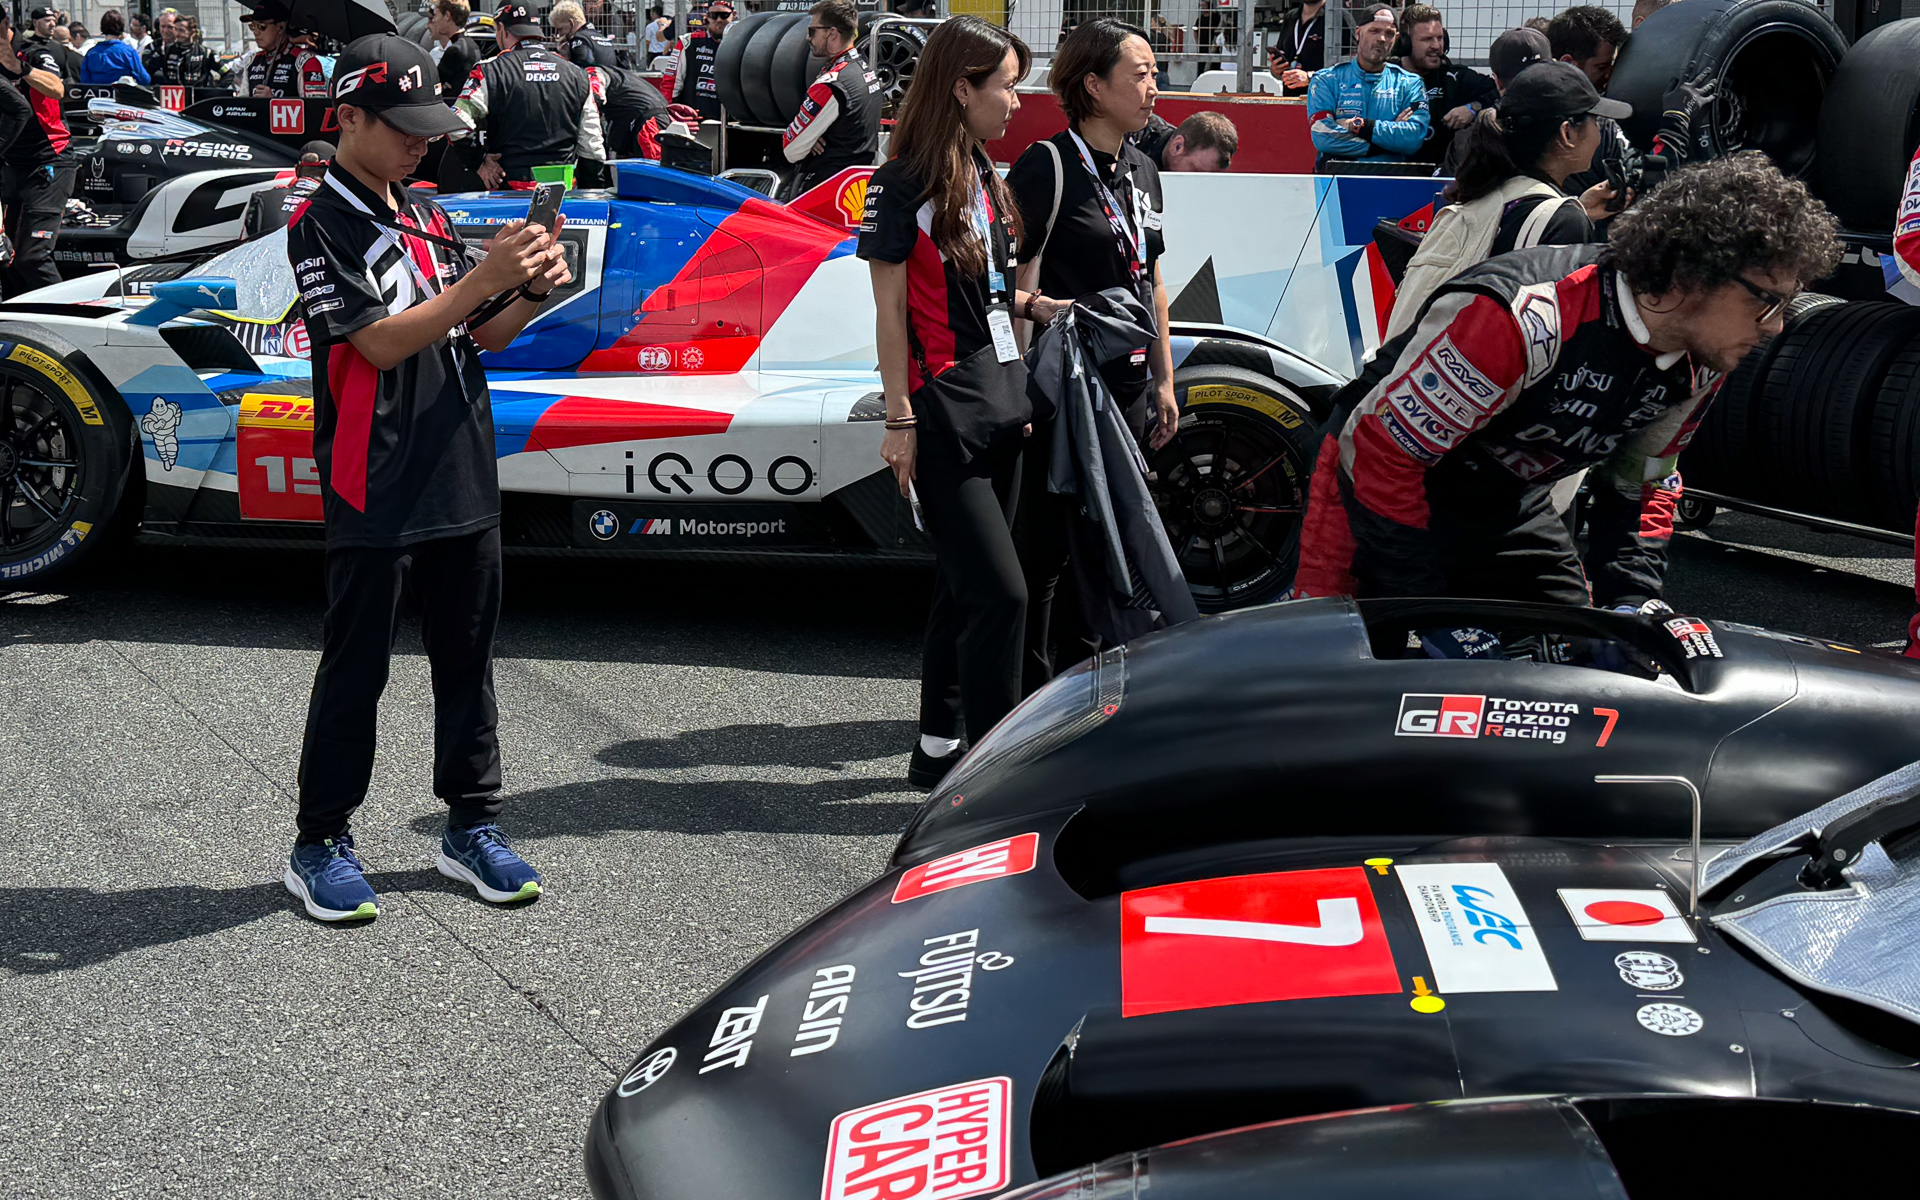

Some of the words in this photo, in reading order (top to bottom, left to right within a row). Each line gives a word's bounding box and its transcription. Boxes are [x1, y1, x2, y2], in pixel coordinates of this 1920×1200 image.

[336, 62, 388, 98] GR
[399, 64, 422, 92] #7
[526, 73, 560, 81] DENSO
[161, 89, 183, 109] HY
[273, 105, 301, 128] HY
[163, 146, 253, 161] HYBRID
[167, 139, 250, 151] RACING
[296, 256, 326, 274] AISIN
[301, 271, 326, 286] ZENT
[268, 341, 278, 354] N
[19, 350, 46, 365] PILOT
[44, 363, 73, 385] SPORT
[1437, 347, 1494, 399] RAYS
[1194, 390, 1222, 399] PILOT
[1225, 390, 1258, 403] SPORT
[1434, 391, 1469, 420] JFE
[259, 400, 314, 420] DH
[679, 518, 787, 537] Motorsport
[1667, 618, 1696, 636] GR
[1701, 633, 1724, 658] TOYOTA
[1400, 710, 1478, 734] GR
[1486, 711, 1571, 727] GAZOO
[1488, 698, 1580, 715] TOYOTA
[1592, 707, 1620, 748] 7
[1484, 724, 1567, 744] Racing
[920, 840, 1011, 888] HY
[1417, 885, 1442, 923] CHAMPIONSHIP
[1144, 897, 1364, 947] 7
[1441, 911, 1464, 947] ENDURANCE
[897, 928, 980, 1030] FUJITSU
[790, 964, 857, 1057] AISIN
[699, 994, 769, 1074] ZENT
[843, 1104, 934, 1200] CAR
[932, 1088, 990, 1194] HYPER
